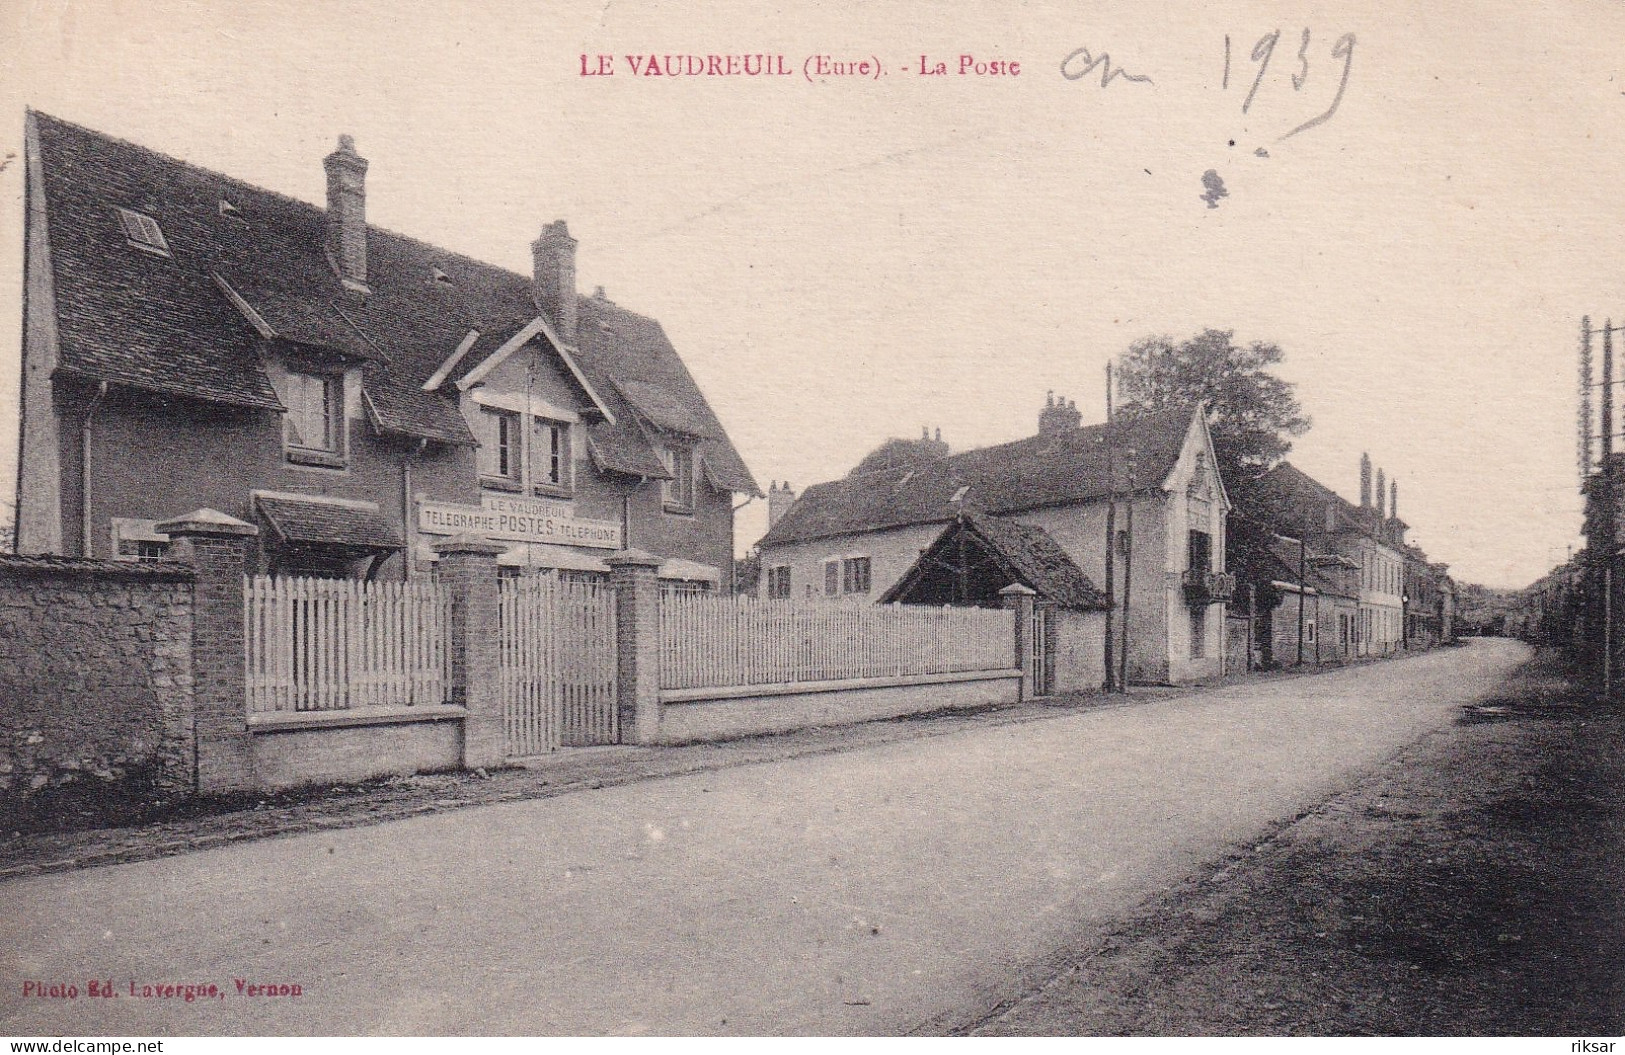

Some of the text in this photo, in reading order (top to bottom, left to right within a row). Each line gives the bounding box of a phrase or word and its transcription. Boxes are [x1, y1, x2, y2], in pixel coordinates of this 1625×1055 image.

[1222, 26, 1357, 141] 1939
[490, 499, 567, 519] LE VAUDREUIL
[499, 514, 554, 536] POSTES
